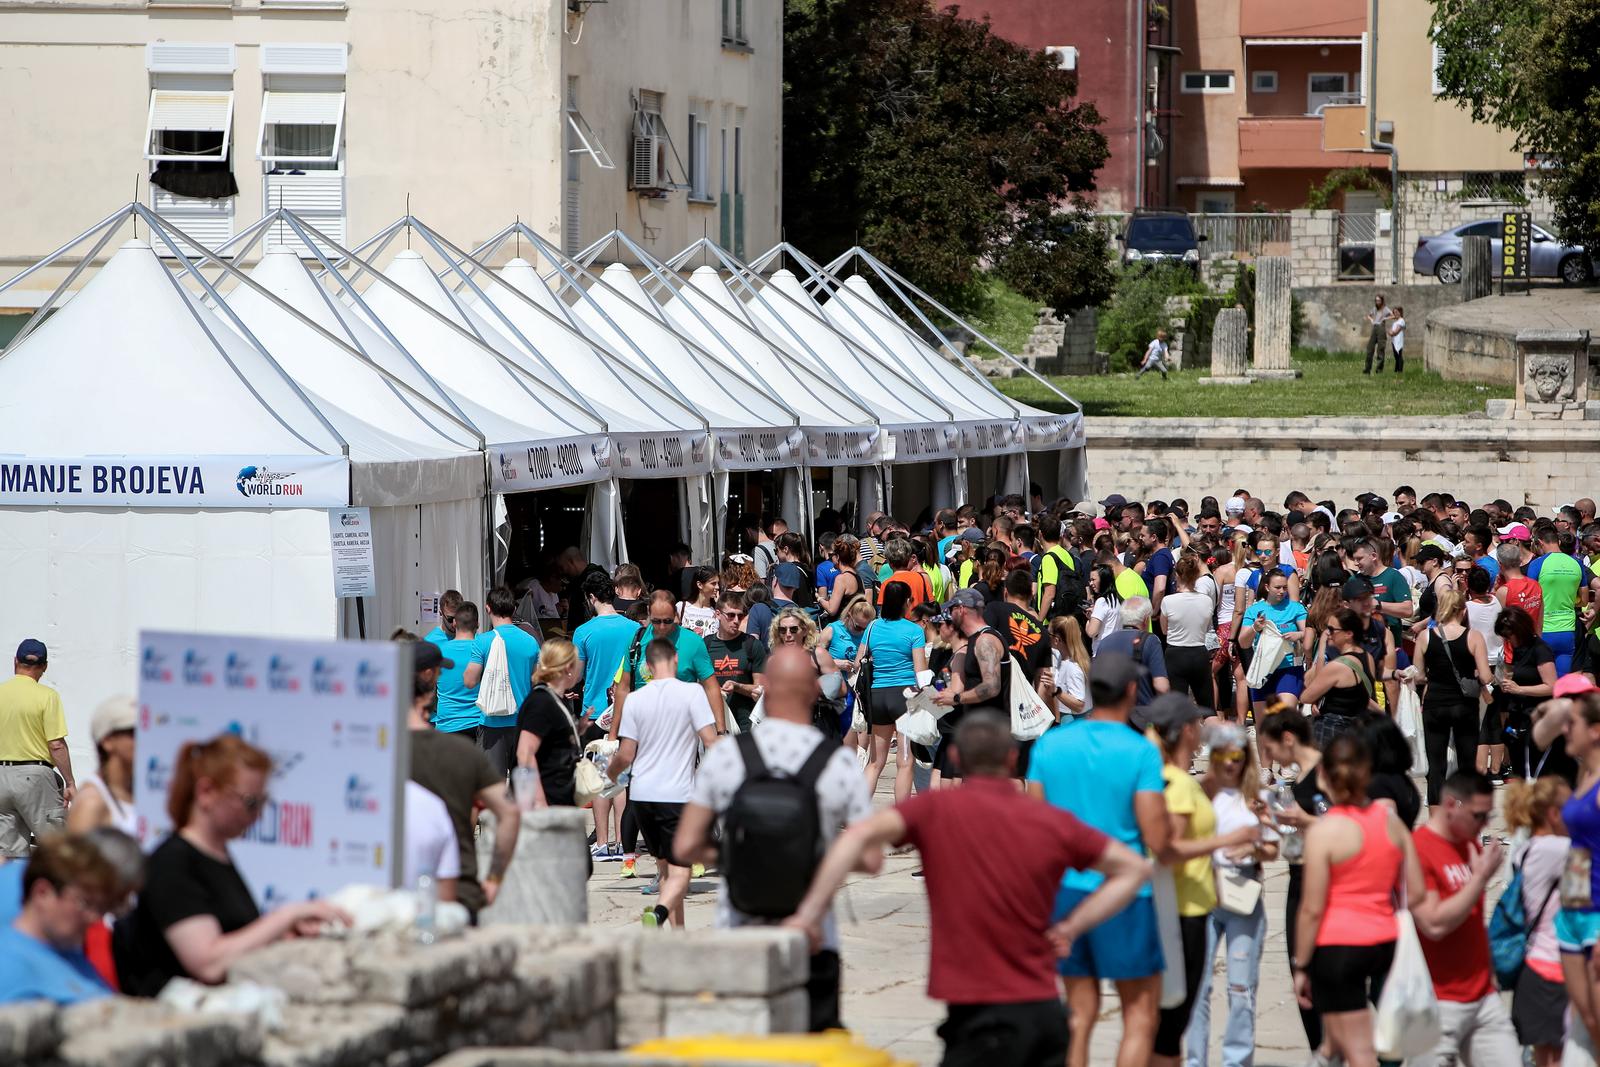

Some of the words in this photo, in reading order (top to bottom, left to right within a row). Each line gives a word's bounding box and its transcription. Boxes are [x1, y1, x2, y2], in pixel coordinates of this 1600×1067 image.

[1504, 214, 1516, 276] KONOBA
[1, 464, 82, 493] MANJE
[93, 465, 205, 494] BROJEVA
[280, 801, 314, 847] RUN
